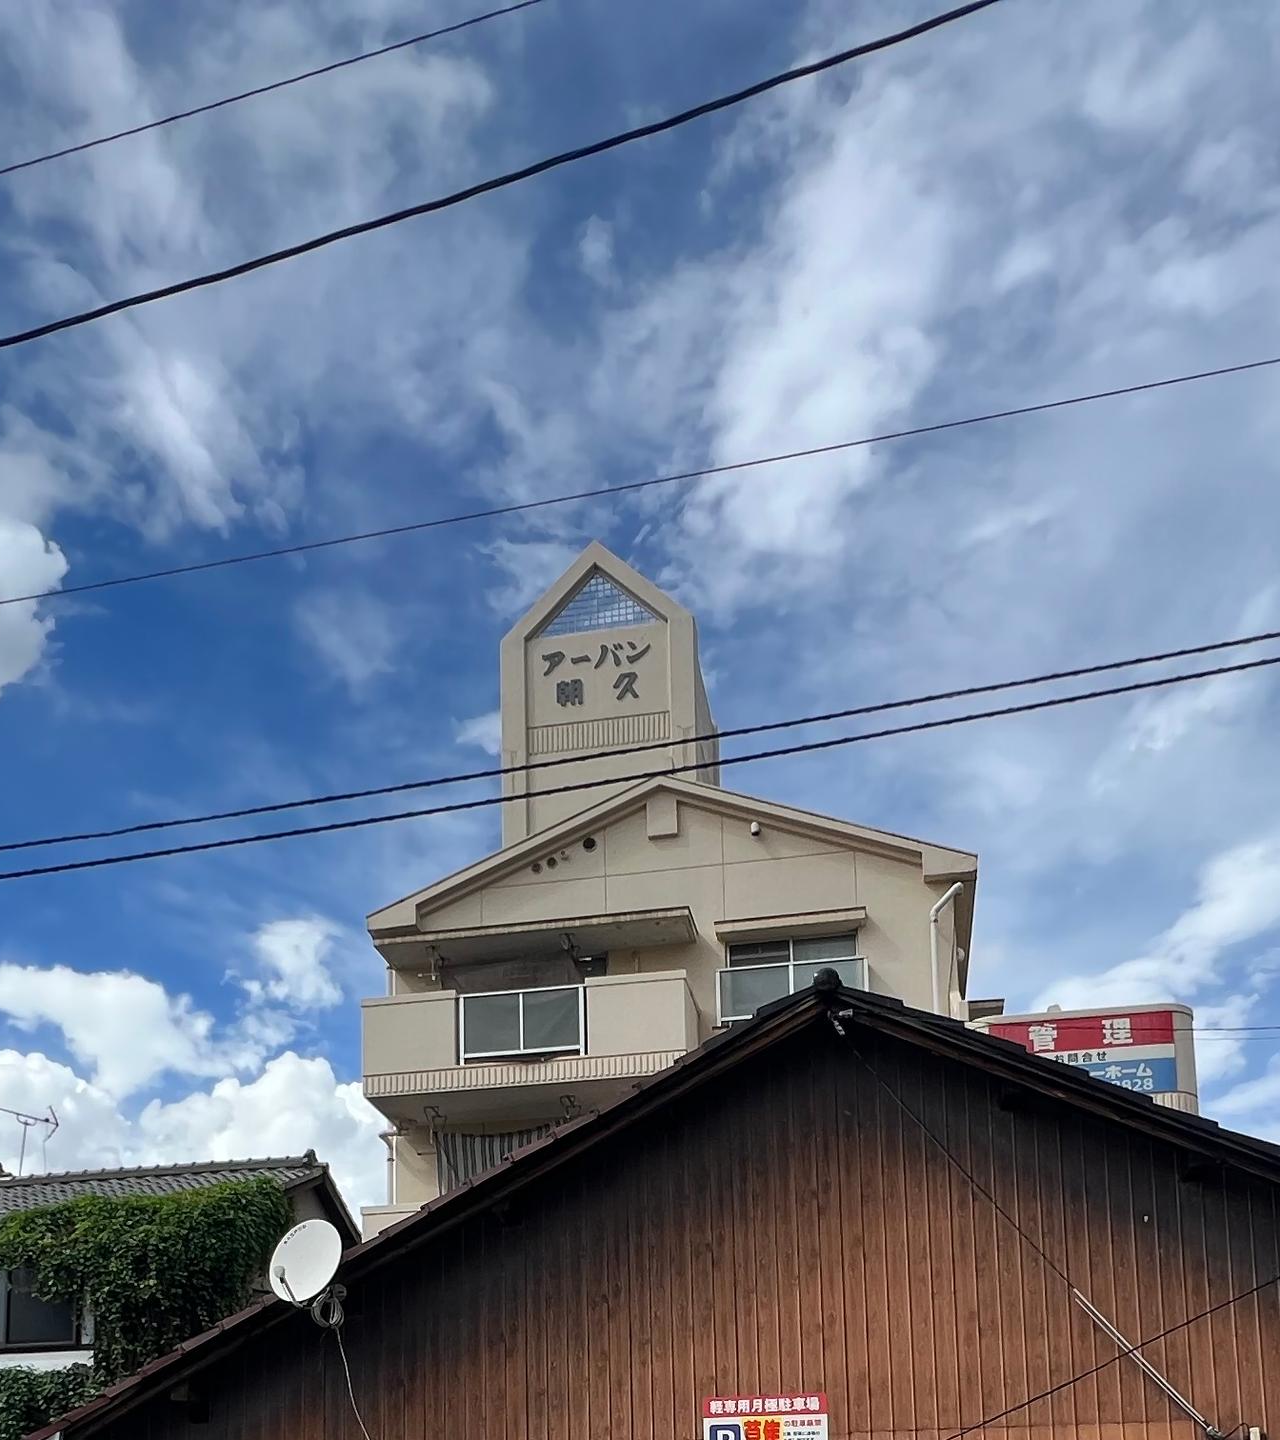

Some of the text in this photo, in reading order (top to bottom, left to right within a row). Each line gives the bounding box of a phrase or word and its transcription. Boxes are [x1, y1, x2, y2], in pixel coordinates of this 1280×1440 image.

[541, 640, 651, 677] アーバン
[556, 672, 639, 706] 朝久
[1028, 1018, 1133, 1052] 管理
[1054, 1051, 1107, 1063] お問合せ
[1079, 1063, 1153, 1080] ーホーム
